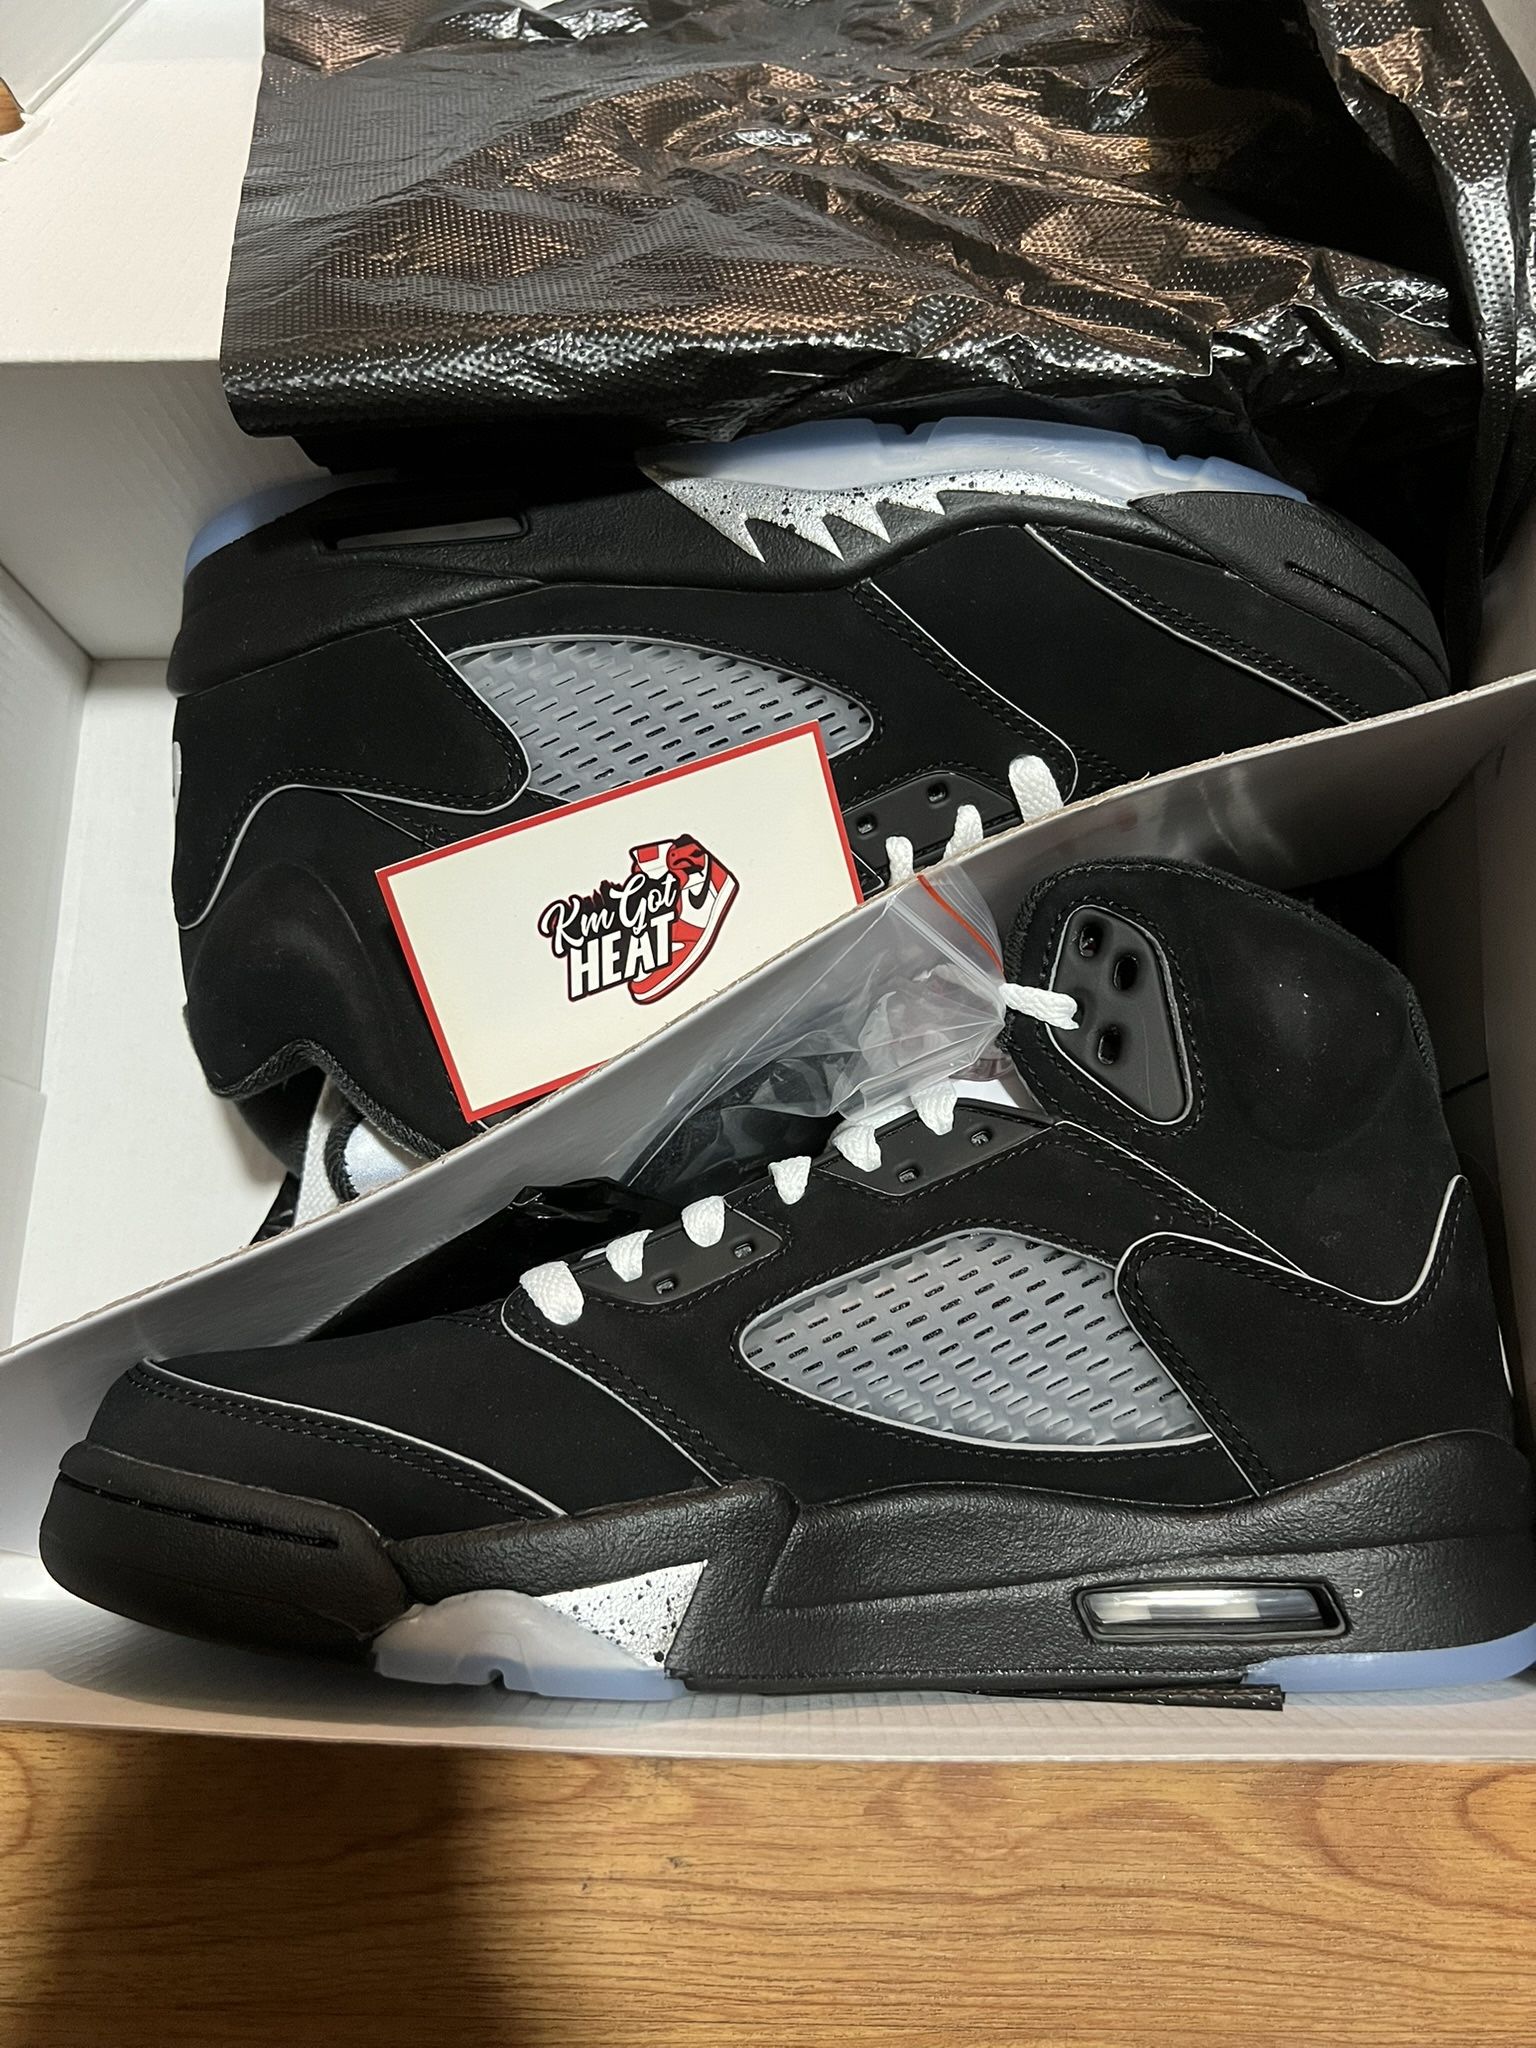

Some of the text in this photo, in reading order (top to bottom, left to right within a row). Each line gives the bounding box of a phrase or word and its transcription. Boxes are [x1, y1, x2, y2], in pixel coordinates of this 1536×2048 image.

[539, 873, 677, 953] Km Got
[570, 911, 676, 998] HEAT
